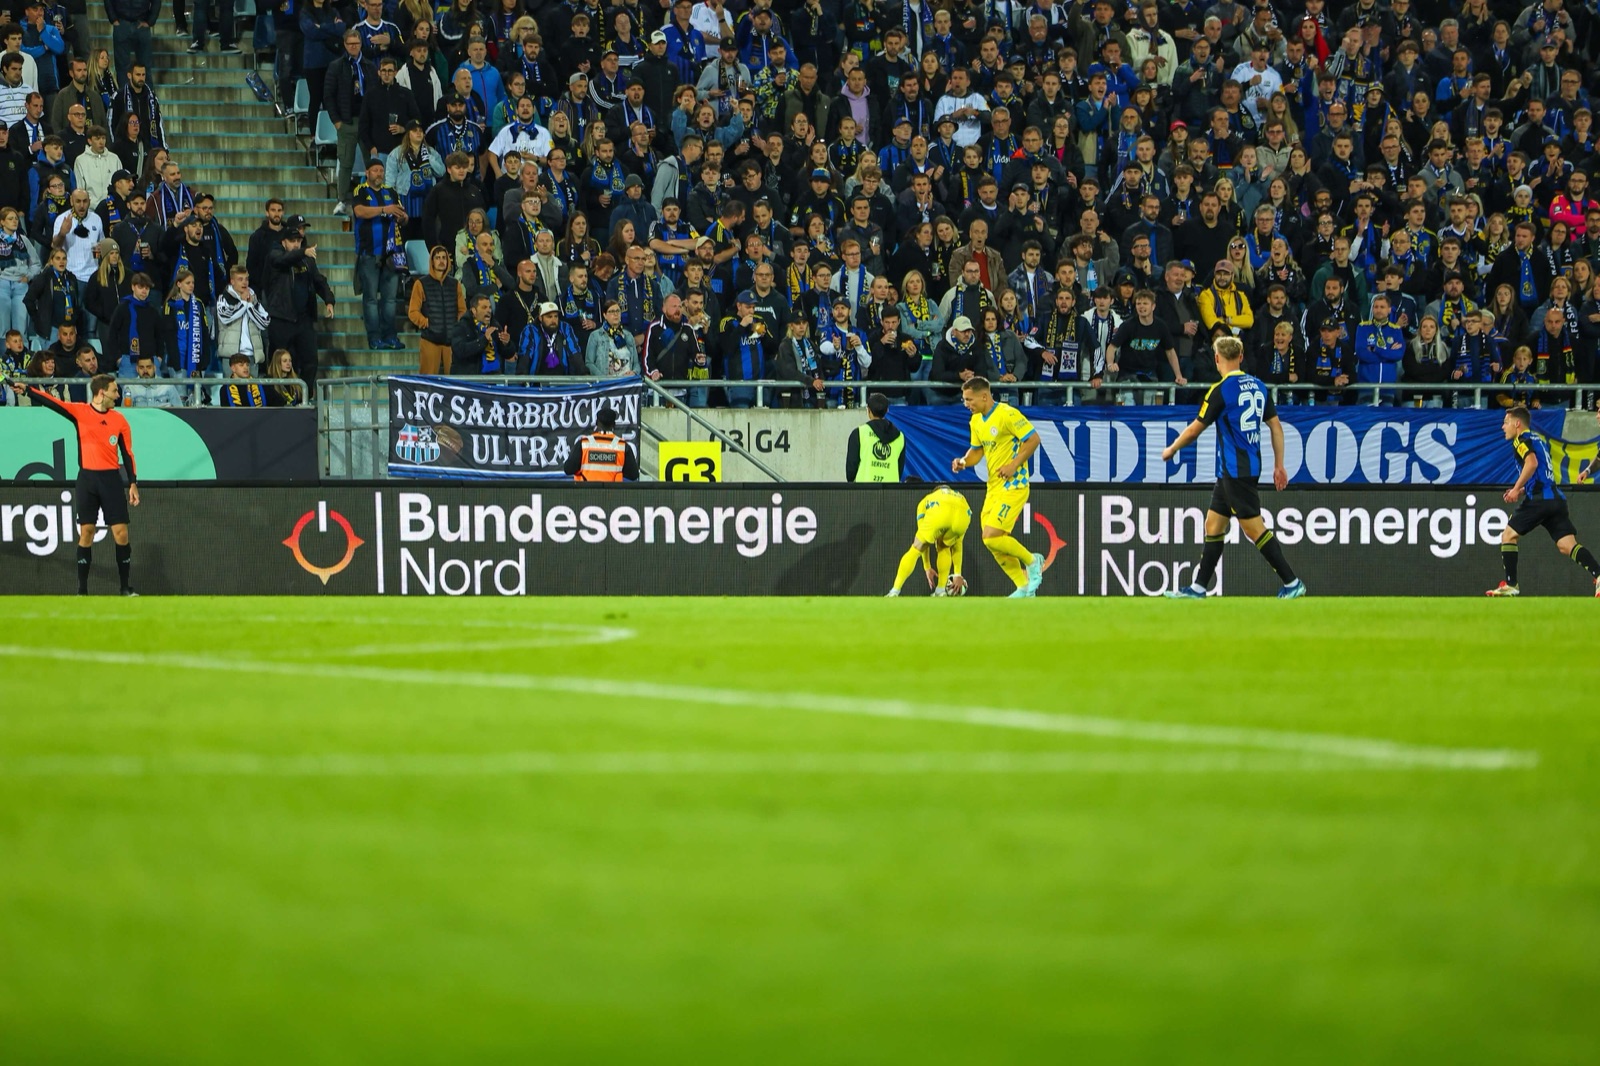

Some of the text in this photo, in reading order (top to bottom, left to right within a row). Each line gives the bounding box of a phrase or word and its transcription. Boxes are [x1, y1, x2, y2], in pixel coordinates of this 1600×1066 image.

[393, 388, 640, 431] 1.FC SAARBRÜCKEN
[1238, 391, 1266, 432] 29
[472, 432, 590, 468] ULTRA
[589, 453, 616, 462] SICHERHEIT
[755, 429, 791, 453] G4
[974, 420, 1457, 484] NDEDOGS
[664, 457, 717, 482] G3
[871, 460, 890, 469] SERVICE
[399, 493, 818, 557] Bundesenergie
[998, 503, 1011, 519] 27
[1101, 494, 1509, 558] Bunsenergie
[400, 547, 526, 596] Nord
